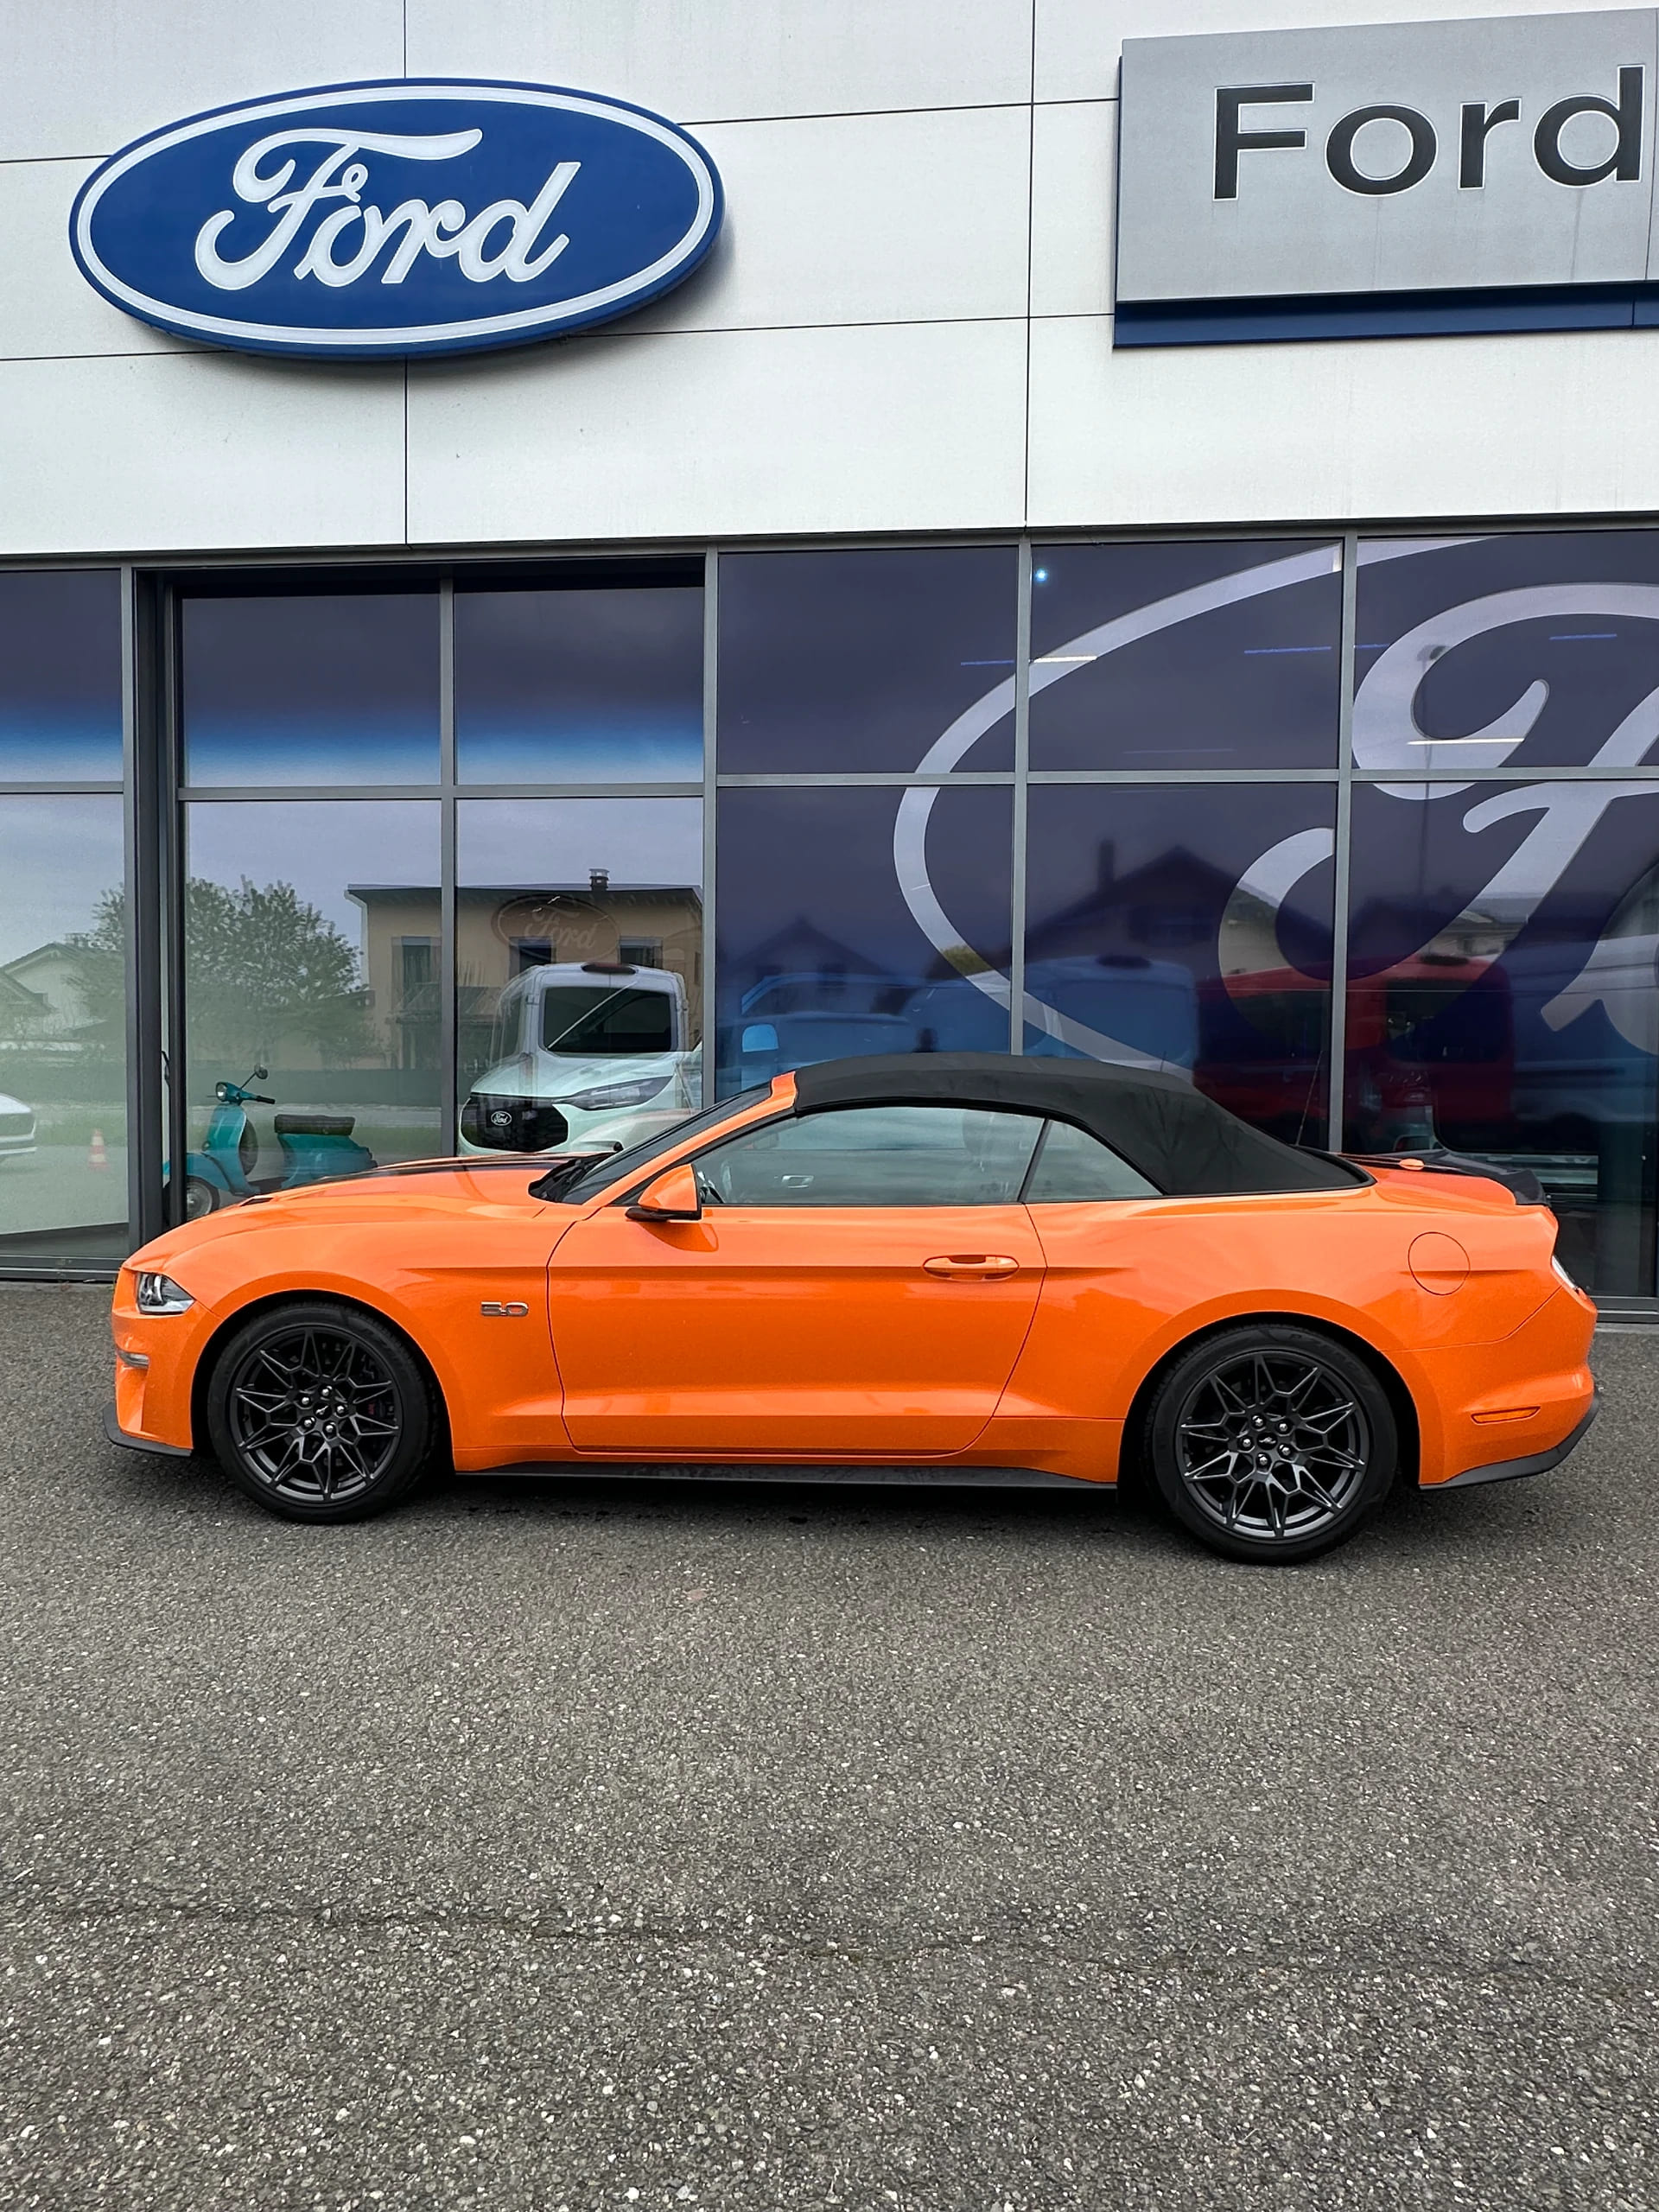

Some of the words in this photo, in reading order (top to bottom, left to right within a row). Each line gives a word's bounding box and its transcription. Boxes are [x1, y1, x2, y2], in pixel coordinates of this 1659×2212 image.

[1212, 64, 1646, 200] Ford
[194, 127, 581, 290] Ford
[480, 1301, 529, 1317] 5.0
